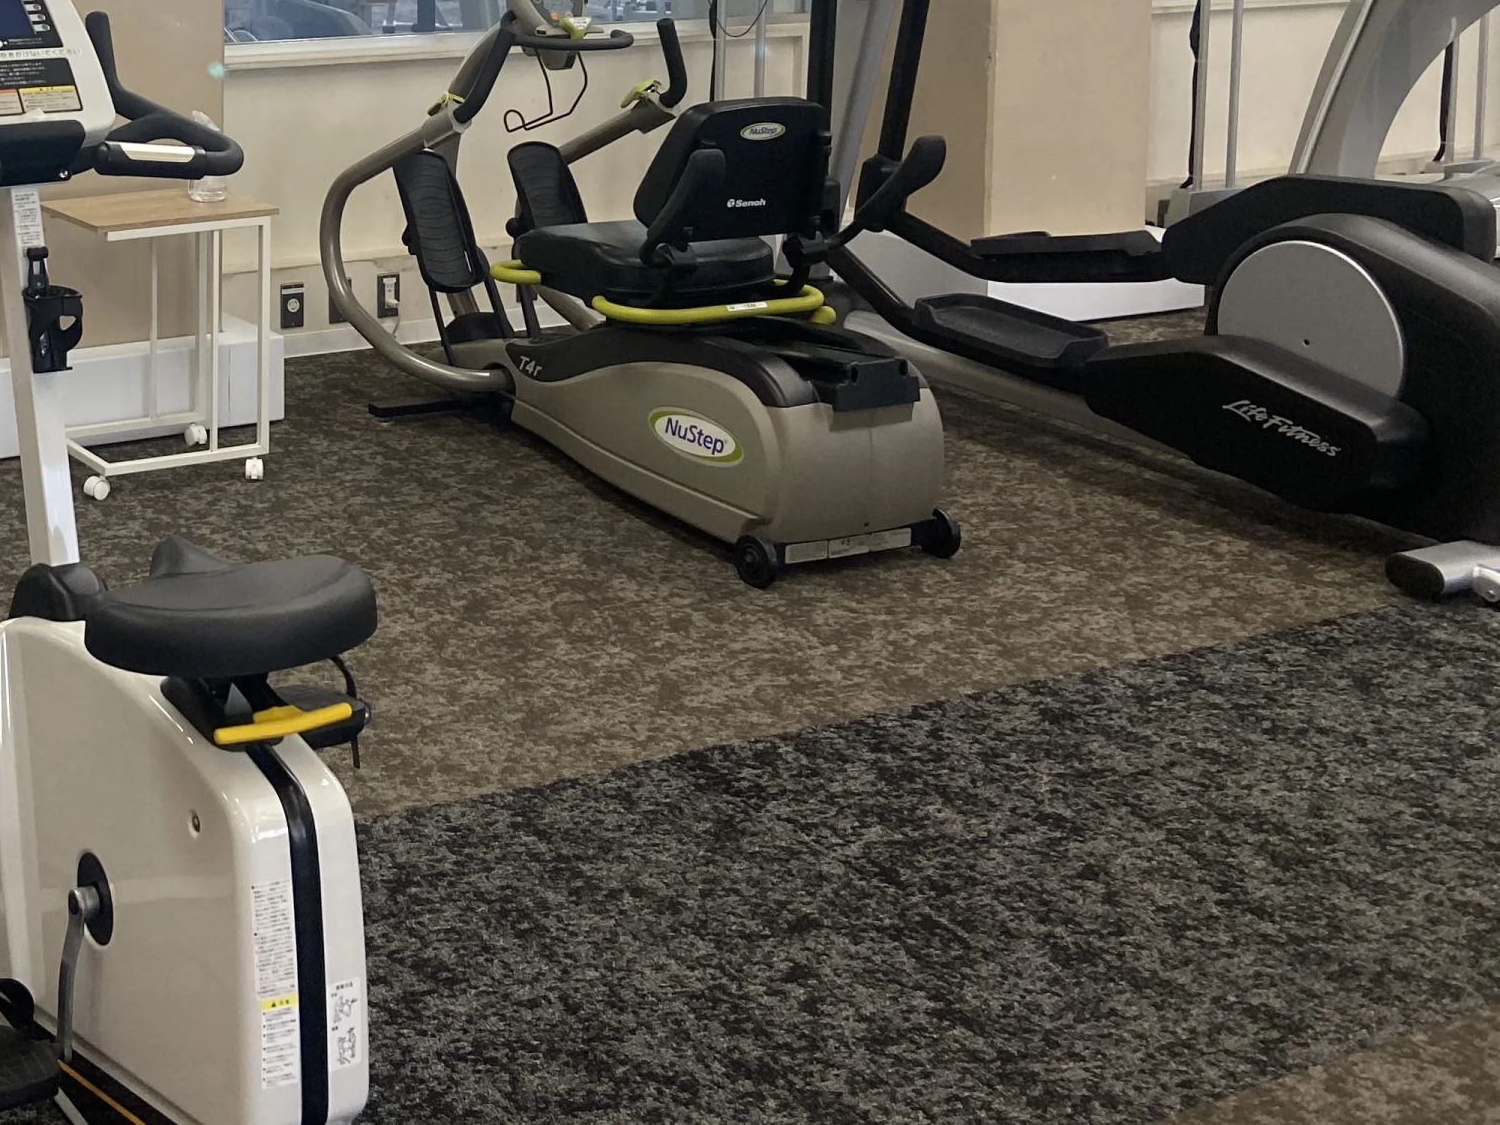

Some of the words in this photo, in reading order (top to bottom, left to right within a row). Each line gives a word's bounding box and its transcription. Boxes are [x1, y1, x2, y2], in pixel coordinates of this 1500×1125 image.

[735, 198, 766, 208] Senoh
[519, 355, 543, 376] T4r
[665, 417, 724, 455] NuStep
[1222, 399, 1269, 422] Life
[1262, 415, 1342, 457] Fitness
